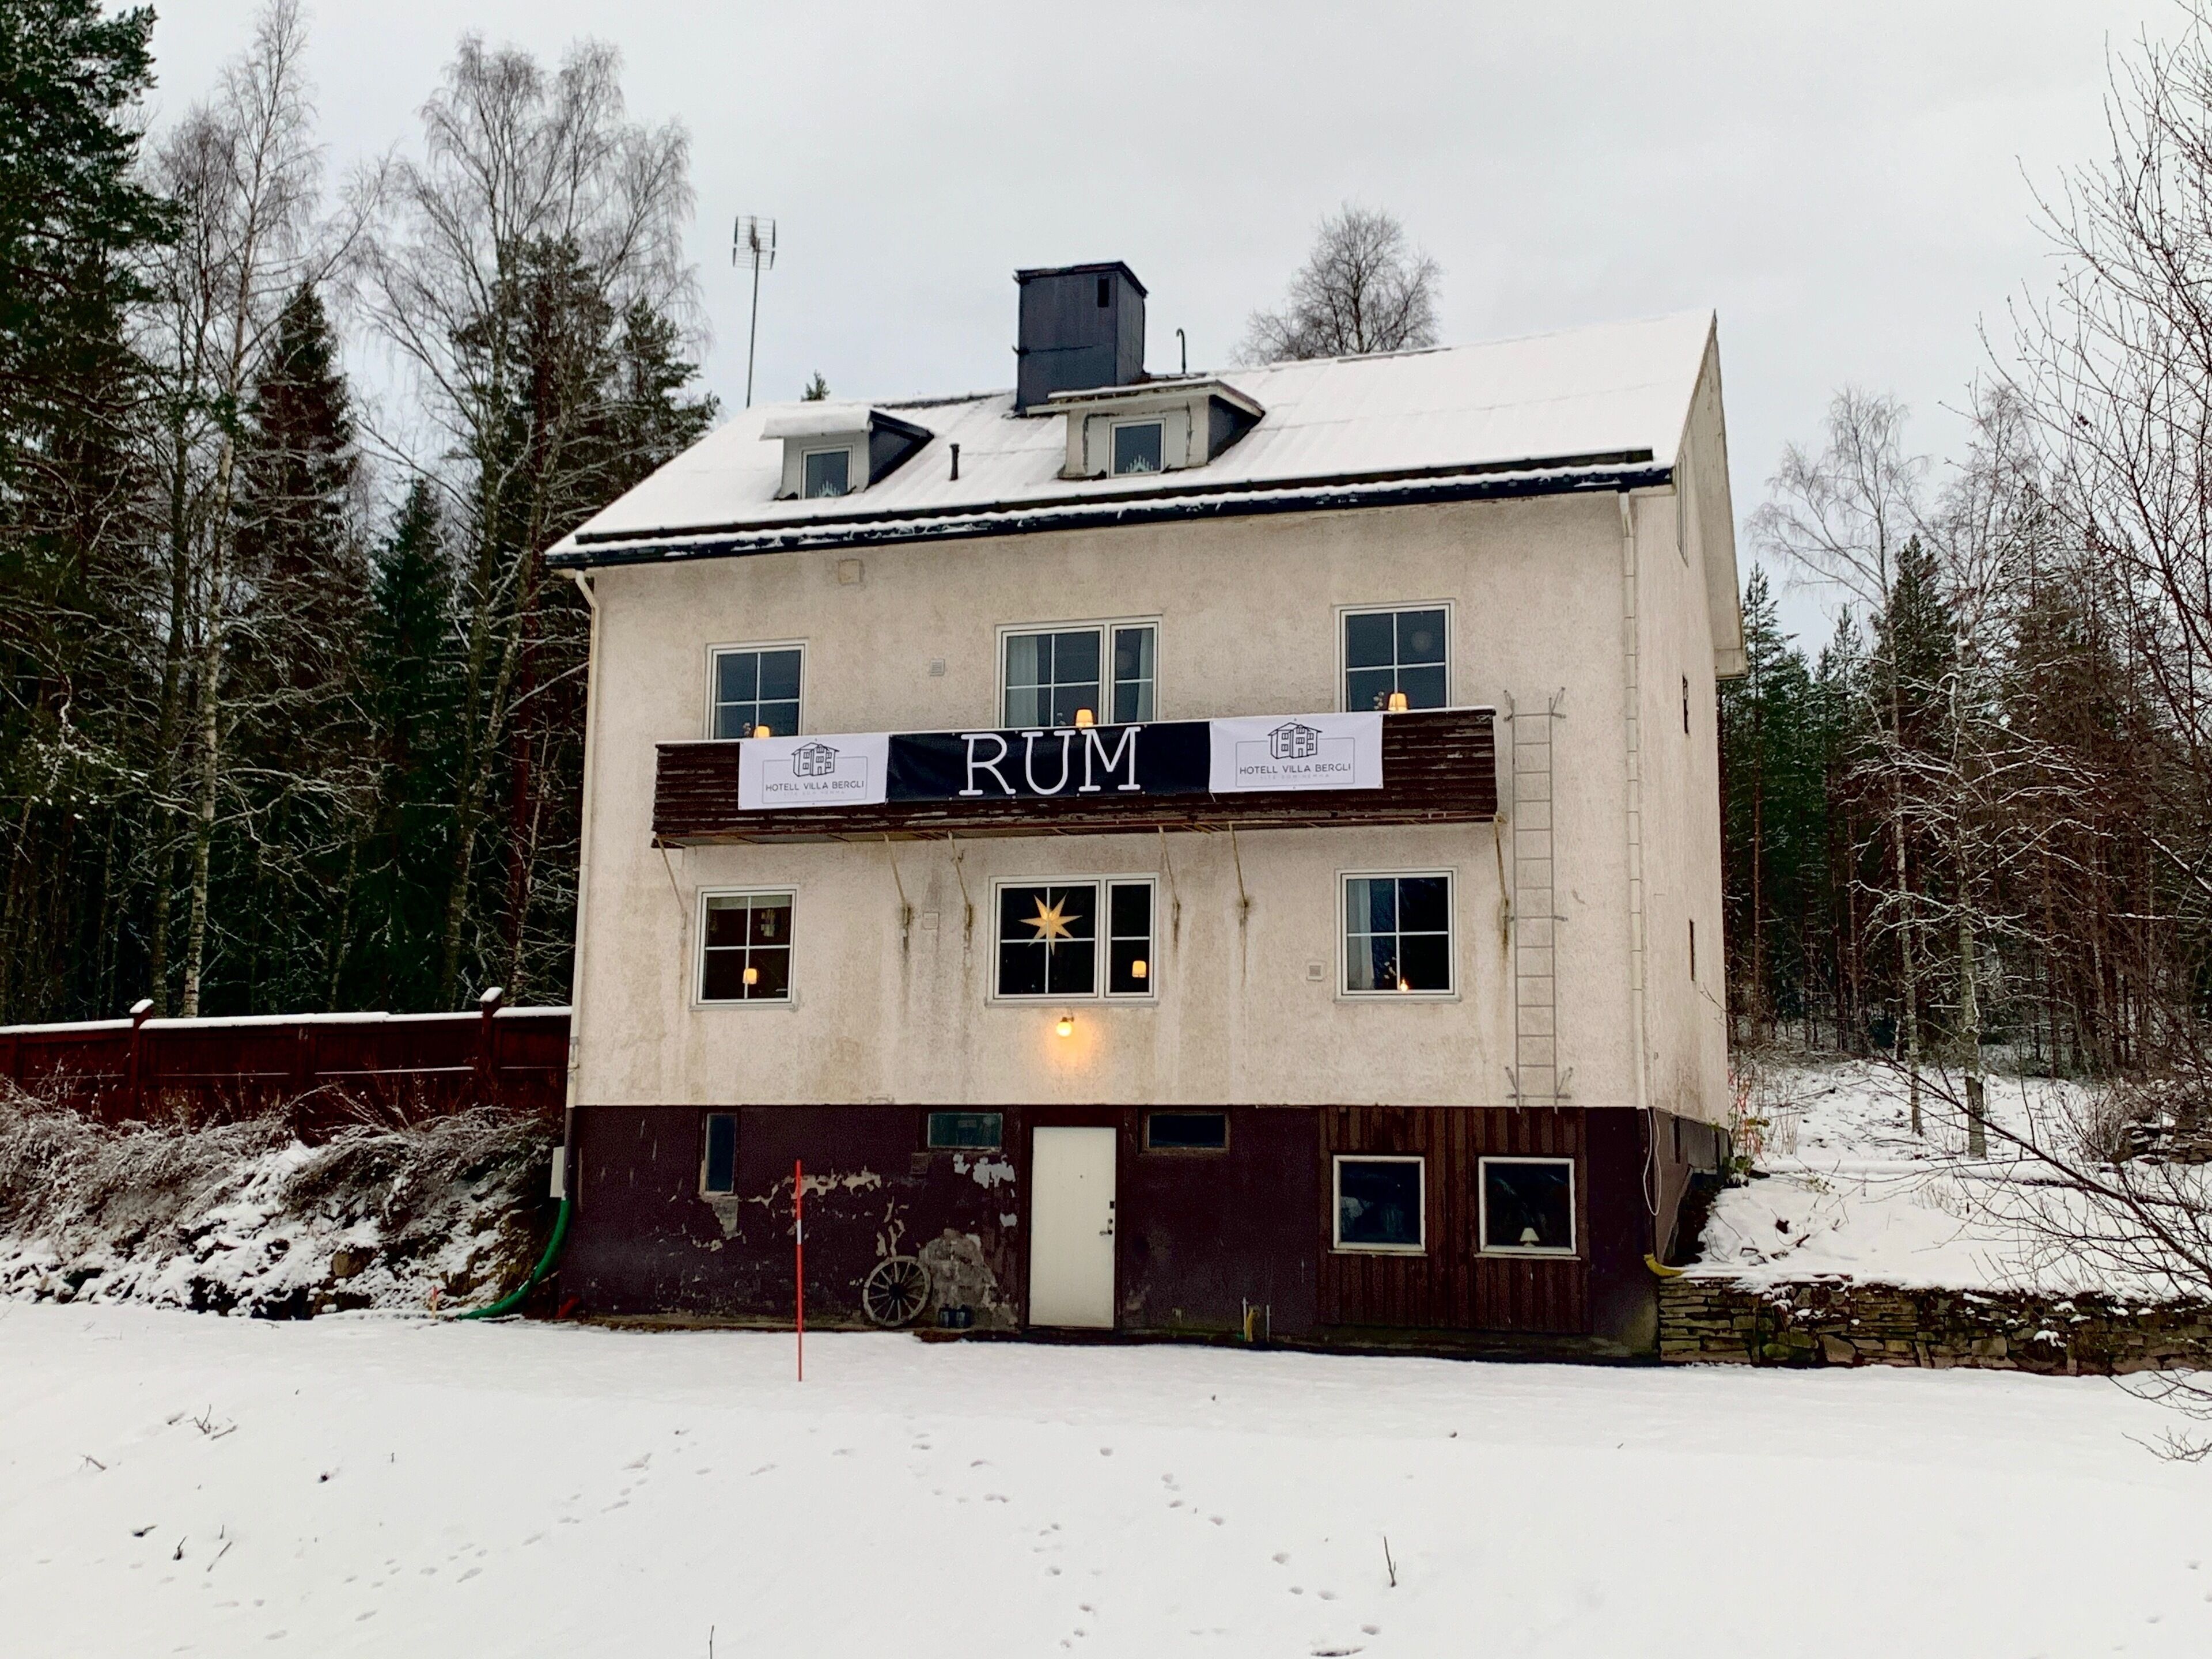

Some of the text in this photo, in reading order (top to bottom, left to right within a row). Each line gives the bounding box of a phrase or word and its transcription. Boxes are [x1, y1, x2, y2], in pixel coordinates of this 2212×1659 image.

[959, 726, 1141, 796] RUM
[1240, 763, 1351, 775] HOTELL VILLA BERGLI
[766, 780, 865, 791] HOTELL VILLA BERGLI
